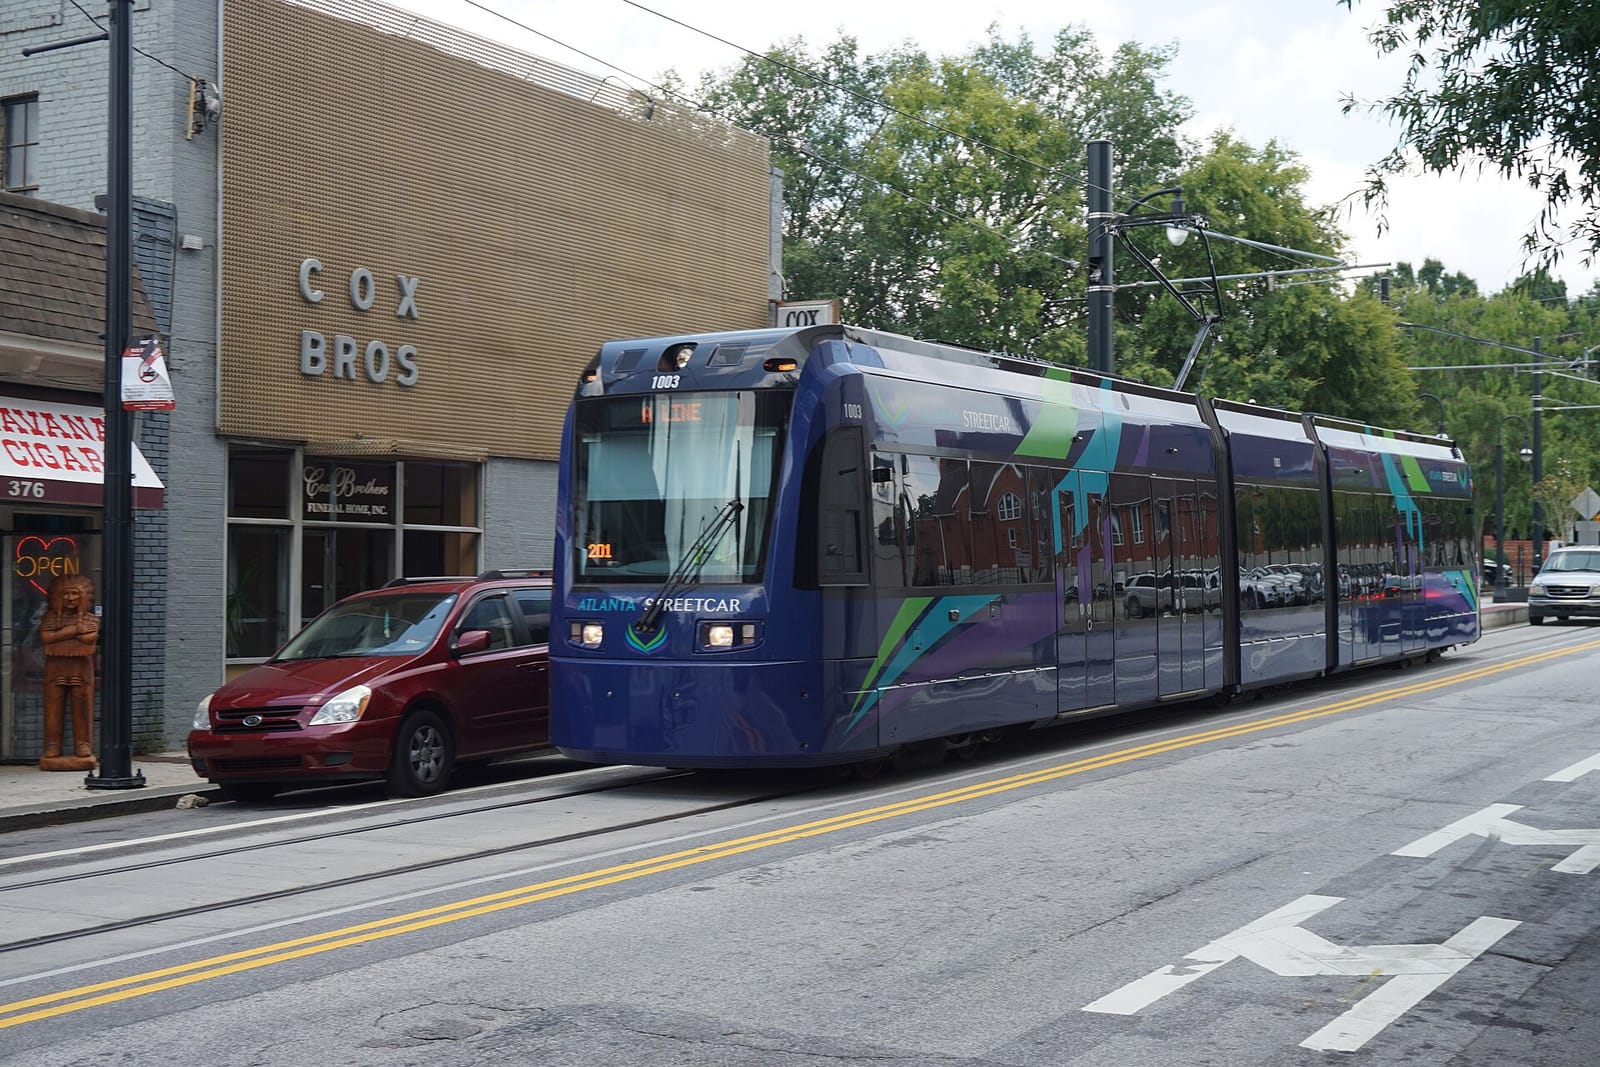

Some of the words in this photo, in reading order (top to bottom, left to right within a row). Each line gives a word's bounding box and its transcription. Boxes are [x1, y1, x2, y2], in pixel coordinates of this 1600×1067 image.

[299, 258, 419, 319] COX
[786, 310, 820, 327] COX
[300, 329, 419, 386] BROS
[651, 375, 680, 390] 1003
[641, 405, 653, 424] A
[660, 402, 703, 423] LINE
[843, 403, 863, 420] 1003
[963, 410, 1010, 432] STREETCAR
[0, 407, 104, 441] AVAN
[8, 480, 45, 497] 376
[334, 467, 389, 497] Brothers
[307, 502, 345, 514] FUNERAL
[371, 505, 388, 515] INC.
[587, 543, 612, 558] 201
[16, 556, 80, 578] OPEN
[577, 598, 636, 611] ATLANTA
[643, 597, 741, 612] SREETCAR
